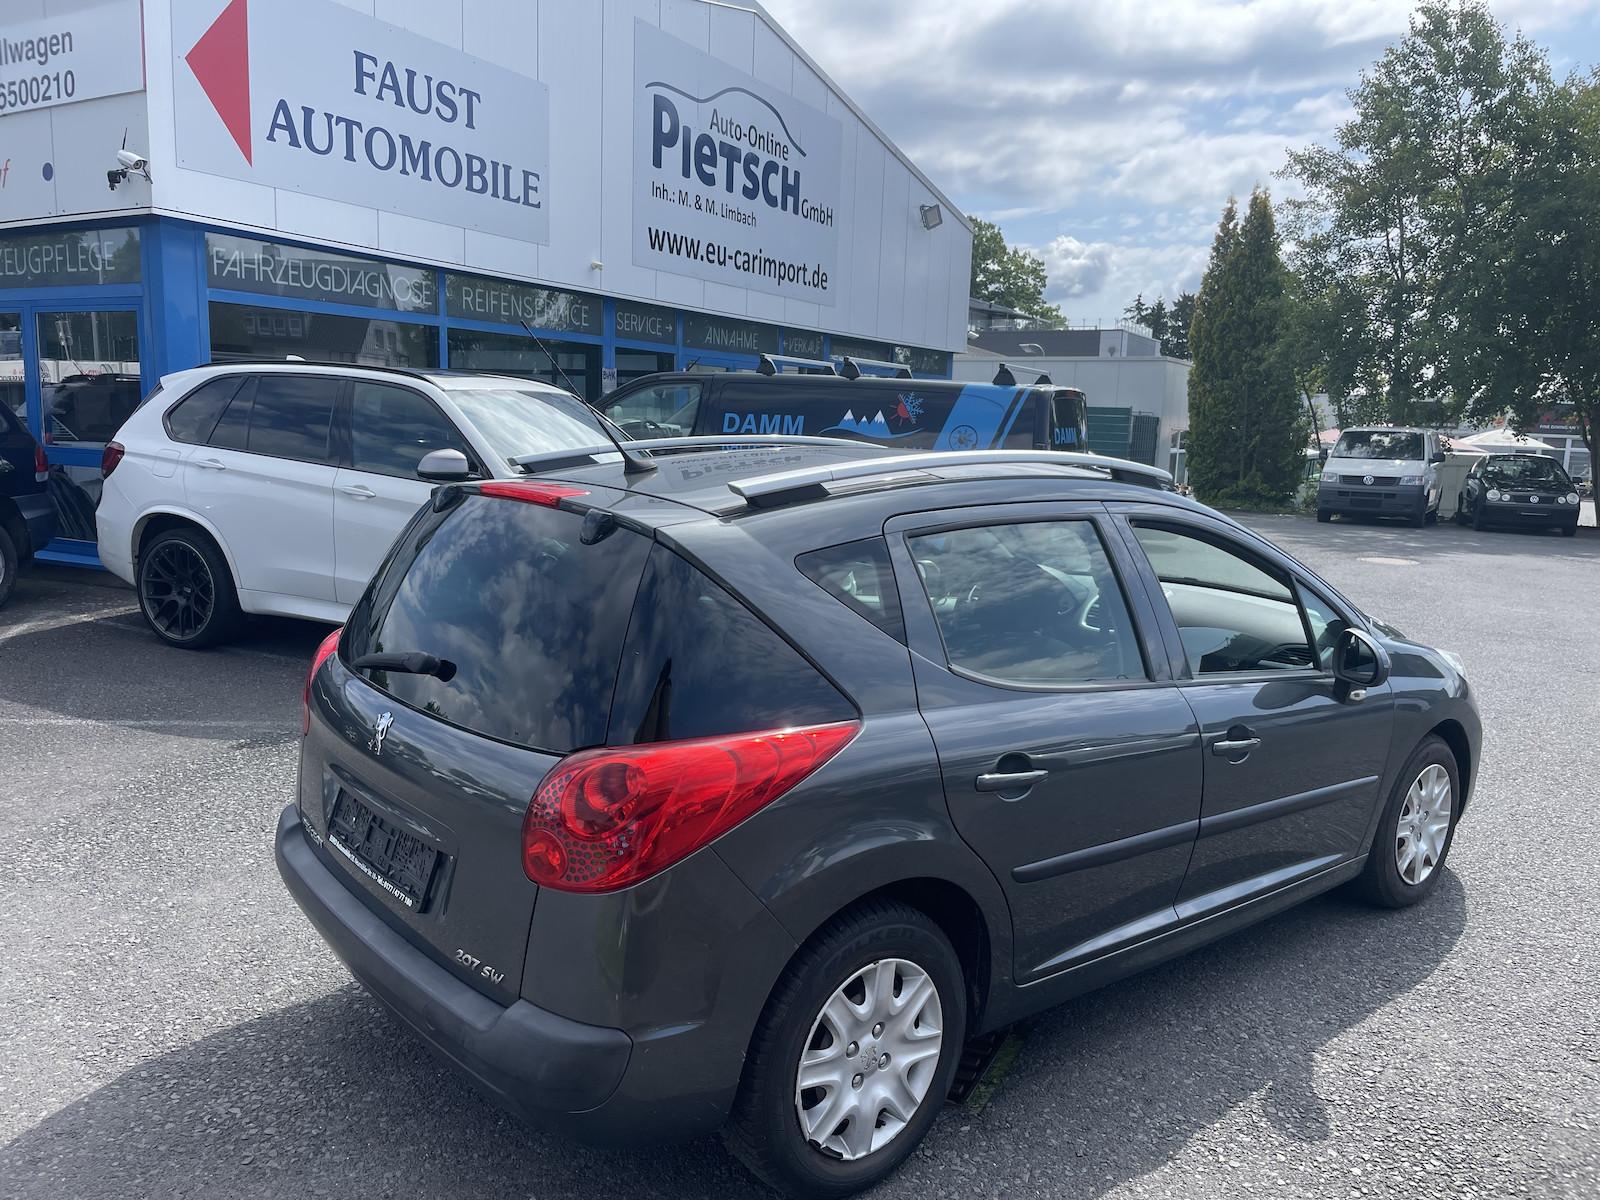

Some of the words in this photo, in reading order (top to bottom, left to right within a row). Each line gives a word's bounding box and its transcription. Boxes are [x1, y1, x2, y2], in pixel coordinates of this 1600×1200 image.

[353, 50, 481, 130] FAUST
[266, 98, 541, 209] AUTOMOBILE
[709, 108, 789, 161] Auto-Online
[651, 180, 676, 203] Inh.:
[678, 189, 692, 209] M.
[694, 194, 703, 212] &
[705, 198, 718, 216] M.
[720, 204, 757, 228] Limbach
[801, 198, 833, 228] GmbH
[213, 247, 433, 306] FAHRZEUGDIAGNOSE
[648, 226, 828, 290] www.eu-carimport.de
[462, 287, 589, 327] REIFENSERVICE
[616, 311, 662, 337] SERVICE
[705, 326, 759, 350] ANNAHME
[722, 412, 805, 436] DAMM
[455, 948, 481, 971] 207
[480, 965, 505, 985] SW
